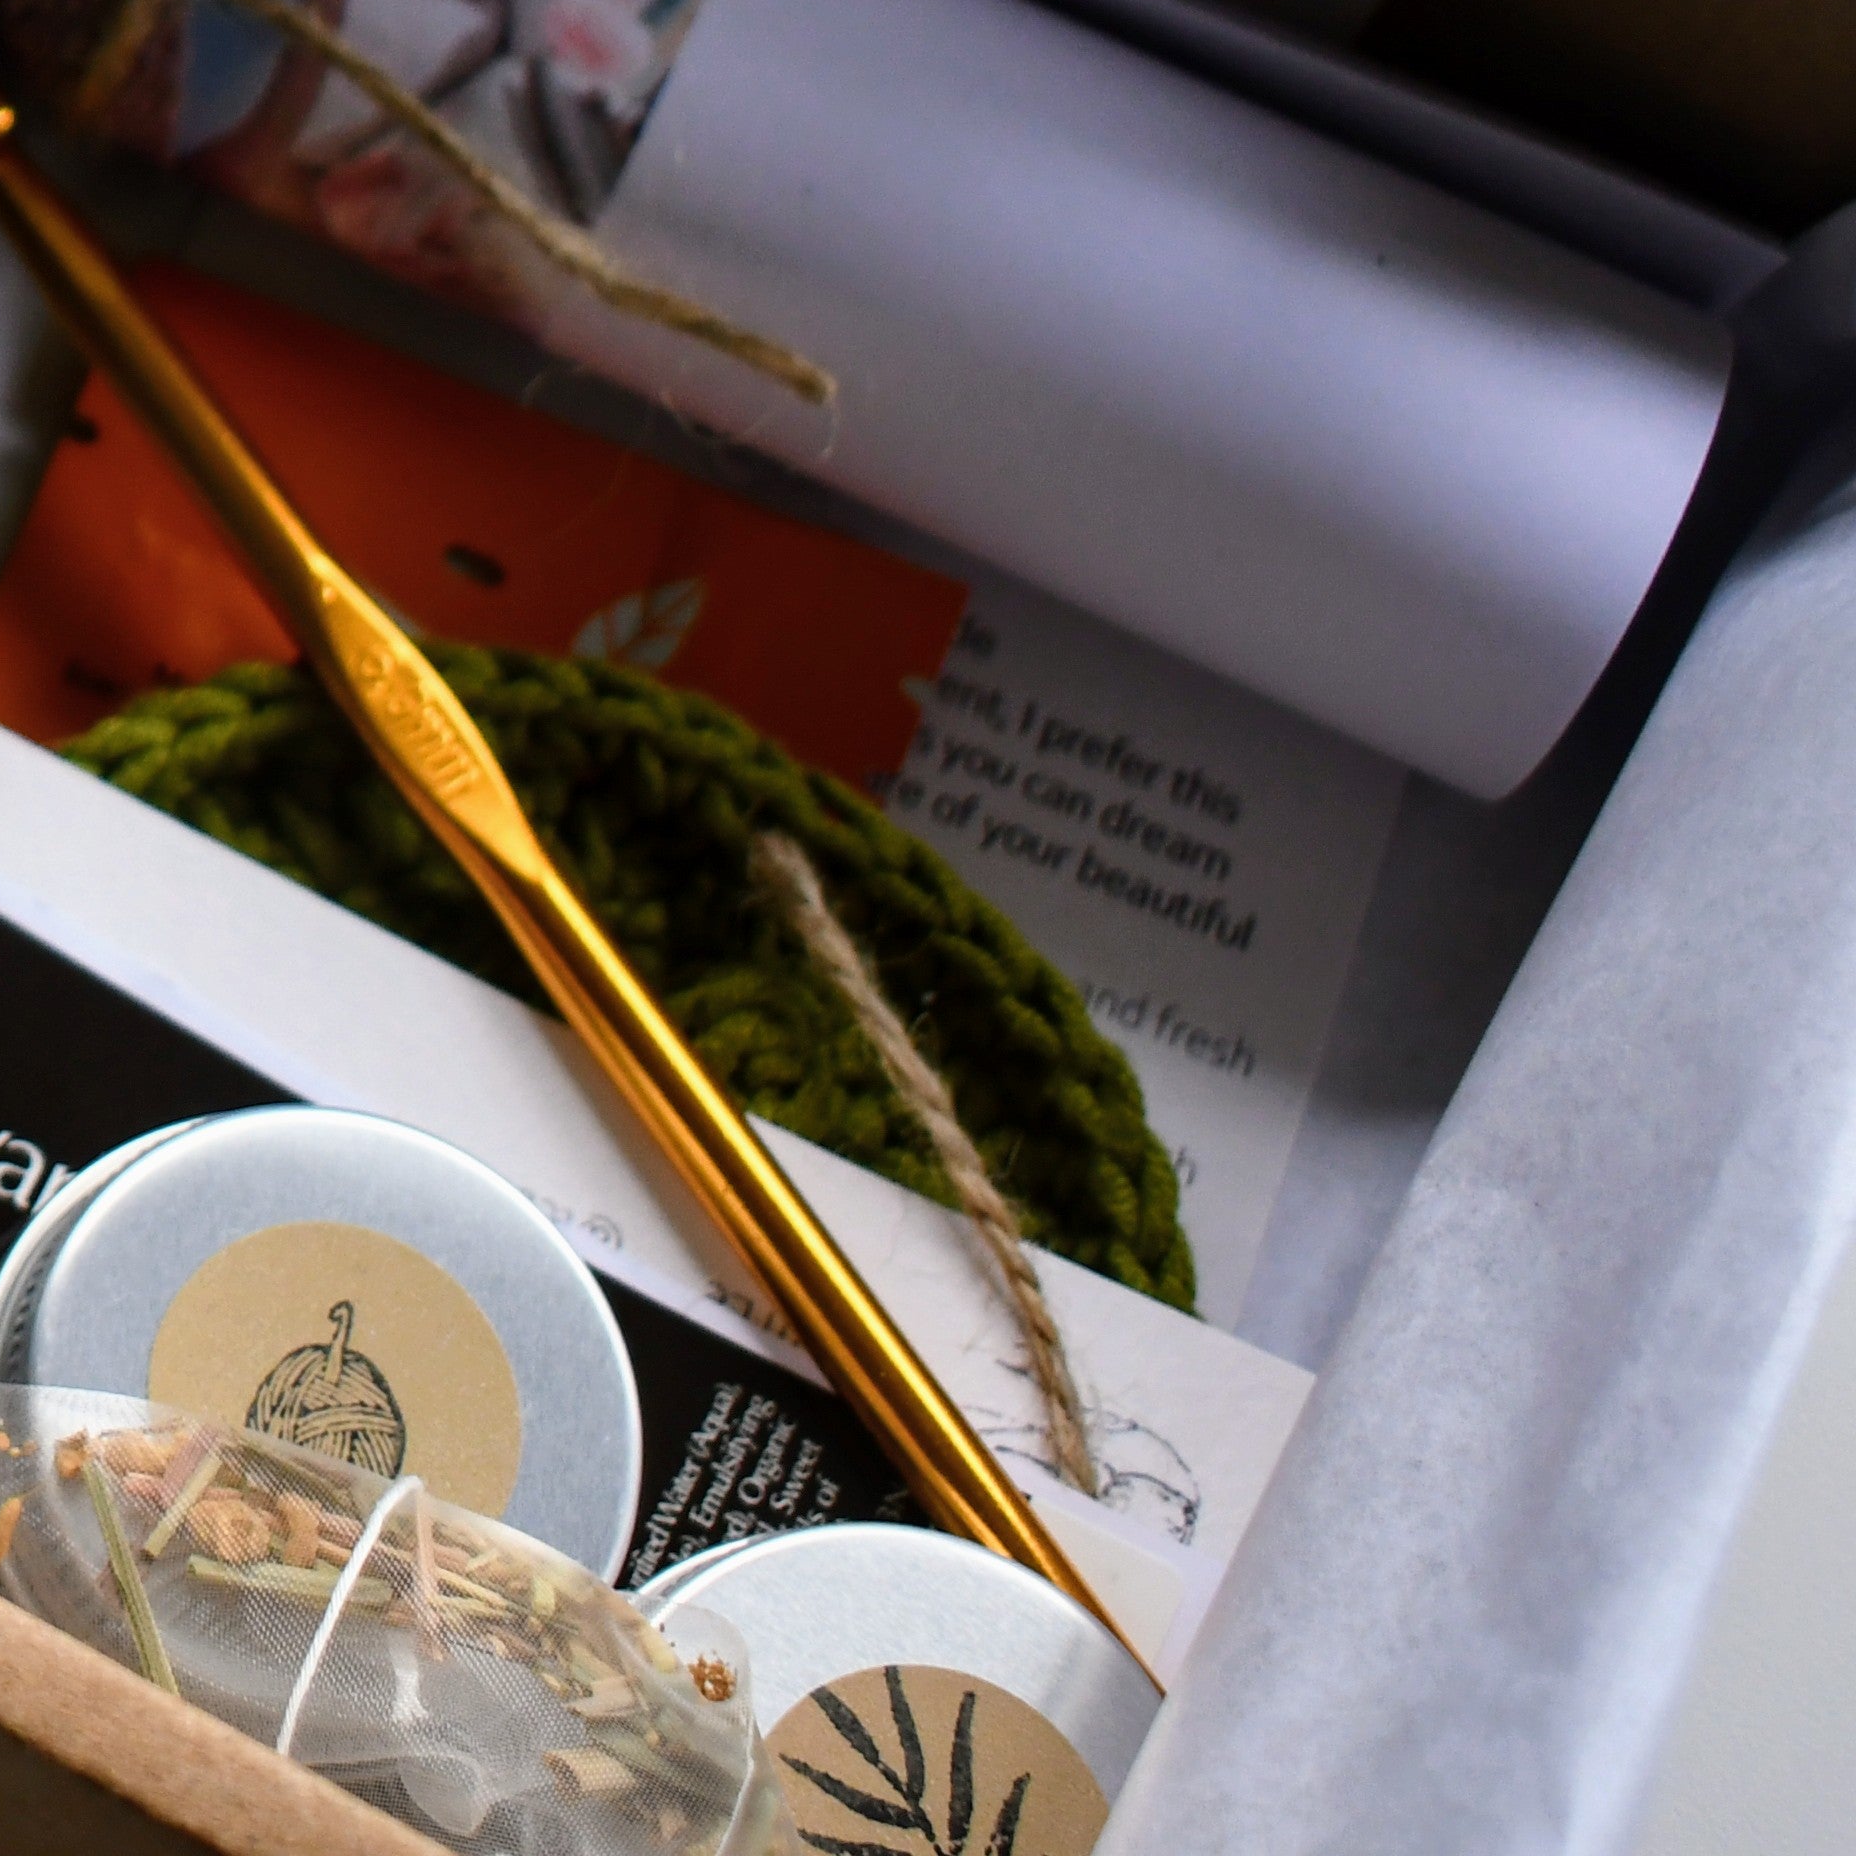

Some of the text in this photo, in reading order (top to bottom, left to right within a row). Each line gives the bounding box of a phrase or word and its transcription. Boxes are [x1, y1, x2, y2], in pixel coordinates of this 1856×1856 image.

[939, 739, 1233, 882] you can dream
[1035, 717, 1164, 789] prefer
[1169, 768, 1241, 825] this
[978, 815, 1073, 871] your
[1075, 845, 1258, 952] beautiful
[1154, 1003, 1256, 1078] fresh
[773, 1439, 822, 1516] Sweet
